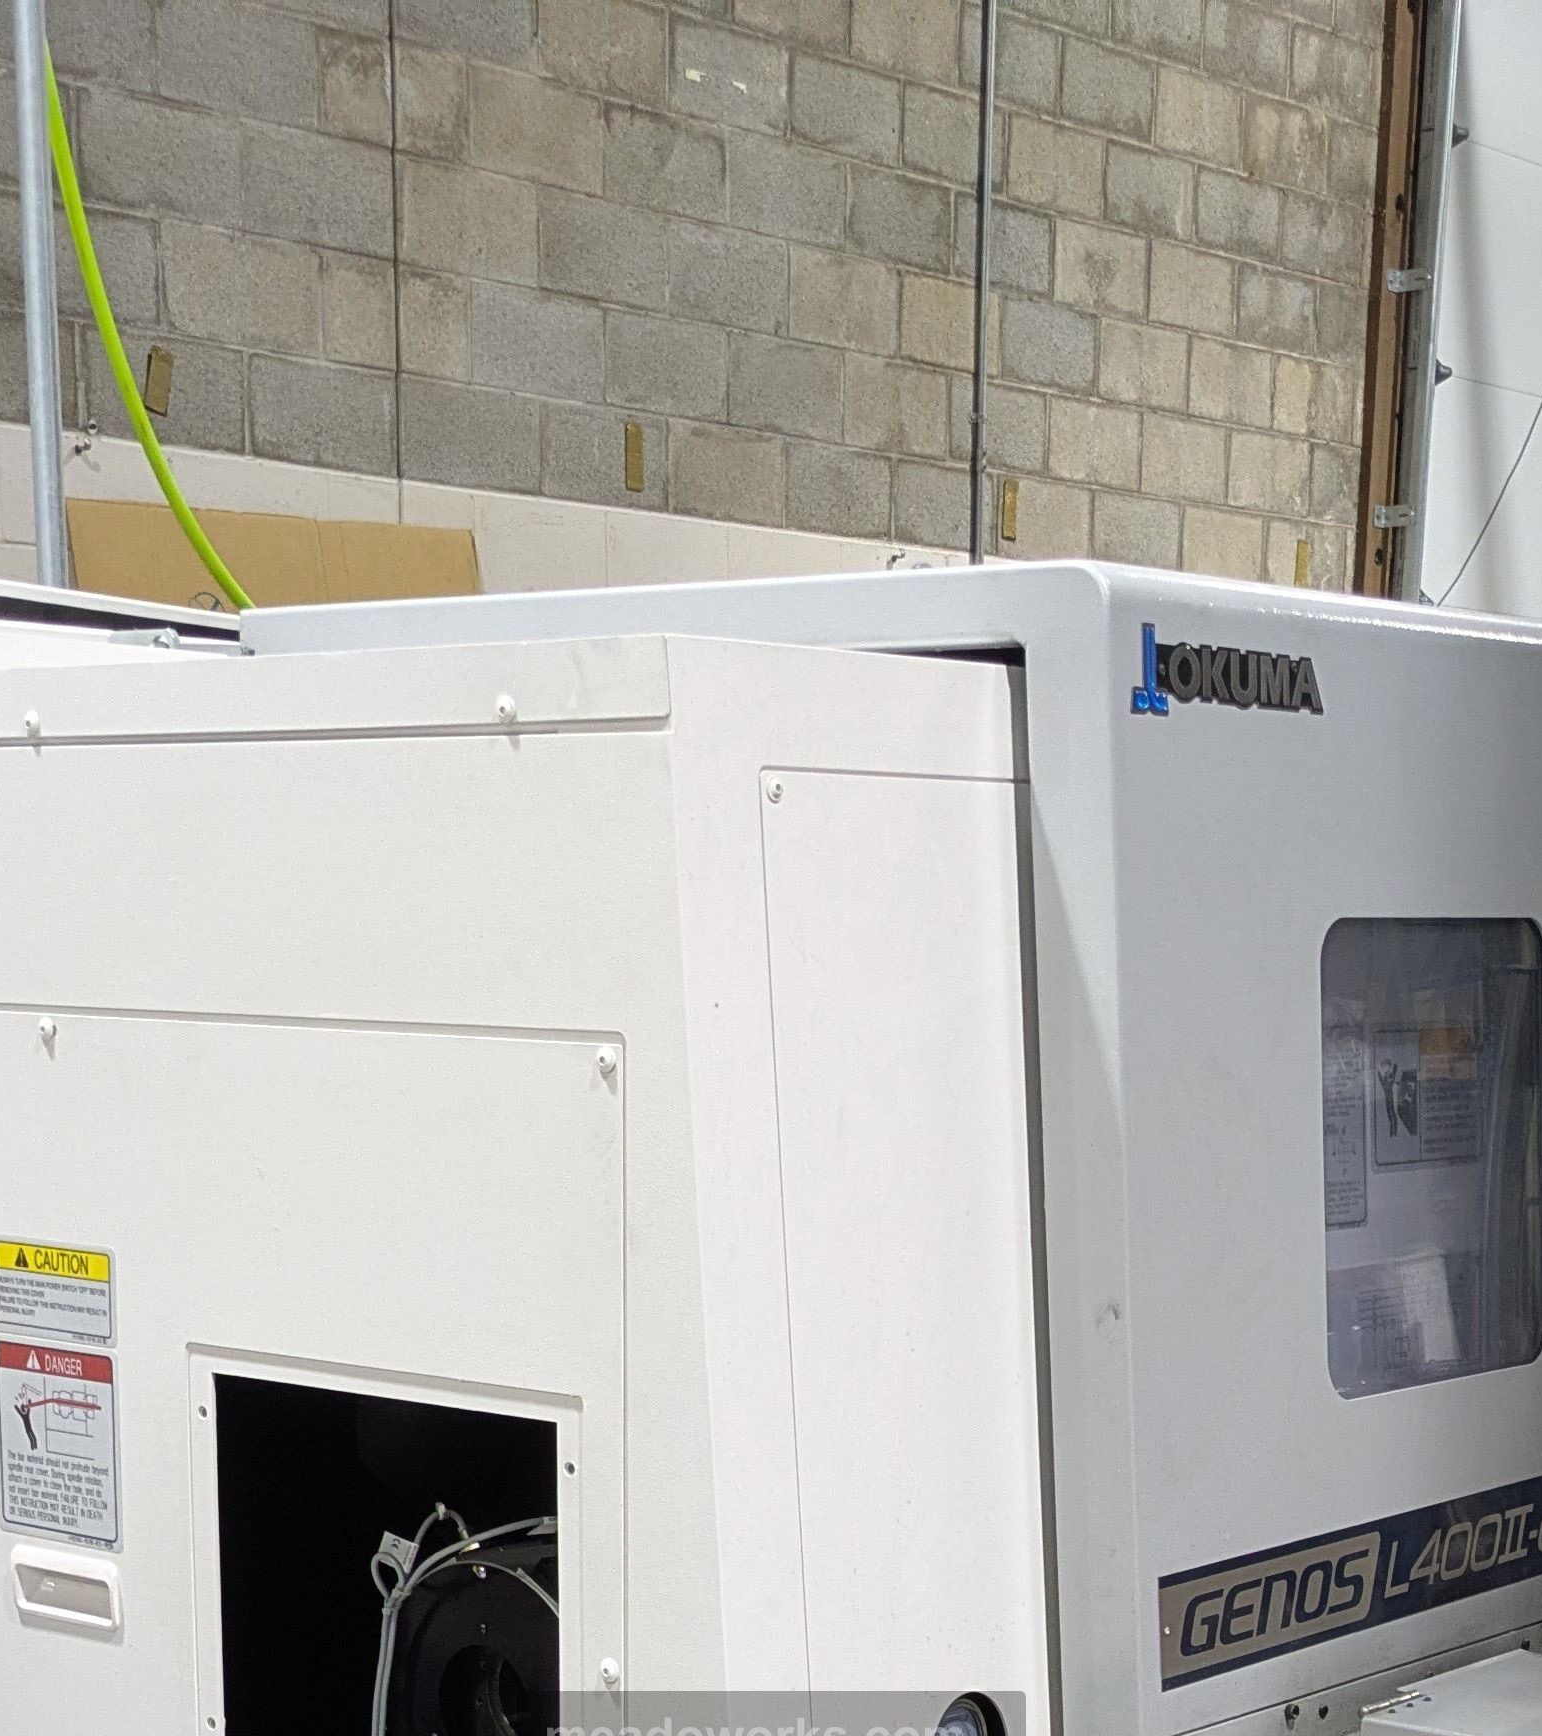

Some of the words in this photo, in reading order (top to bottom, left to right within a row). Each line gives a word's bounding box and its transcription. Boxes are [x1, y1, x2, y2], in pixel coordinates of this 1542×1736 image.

[1168, 642, 1324, 716] OKUMA
[34, 1249, 89, 1275] CAUTION
[45, 1354, 83, 1376] DANGER
[1180, 1548, 1370, 1657] GENOS
